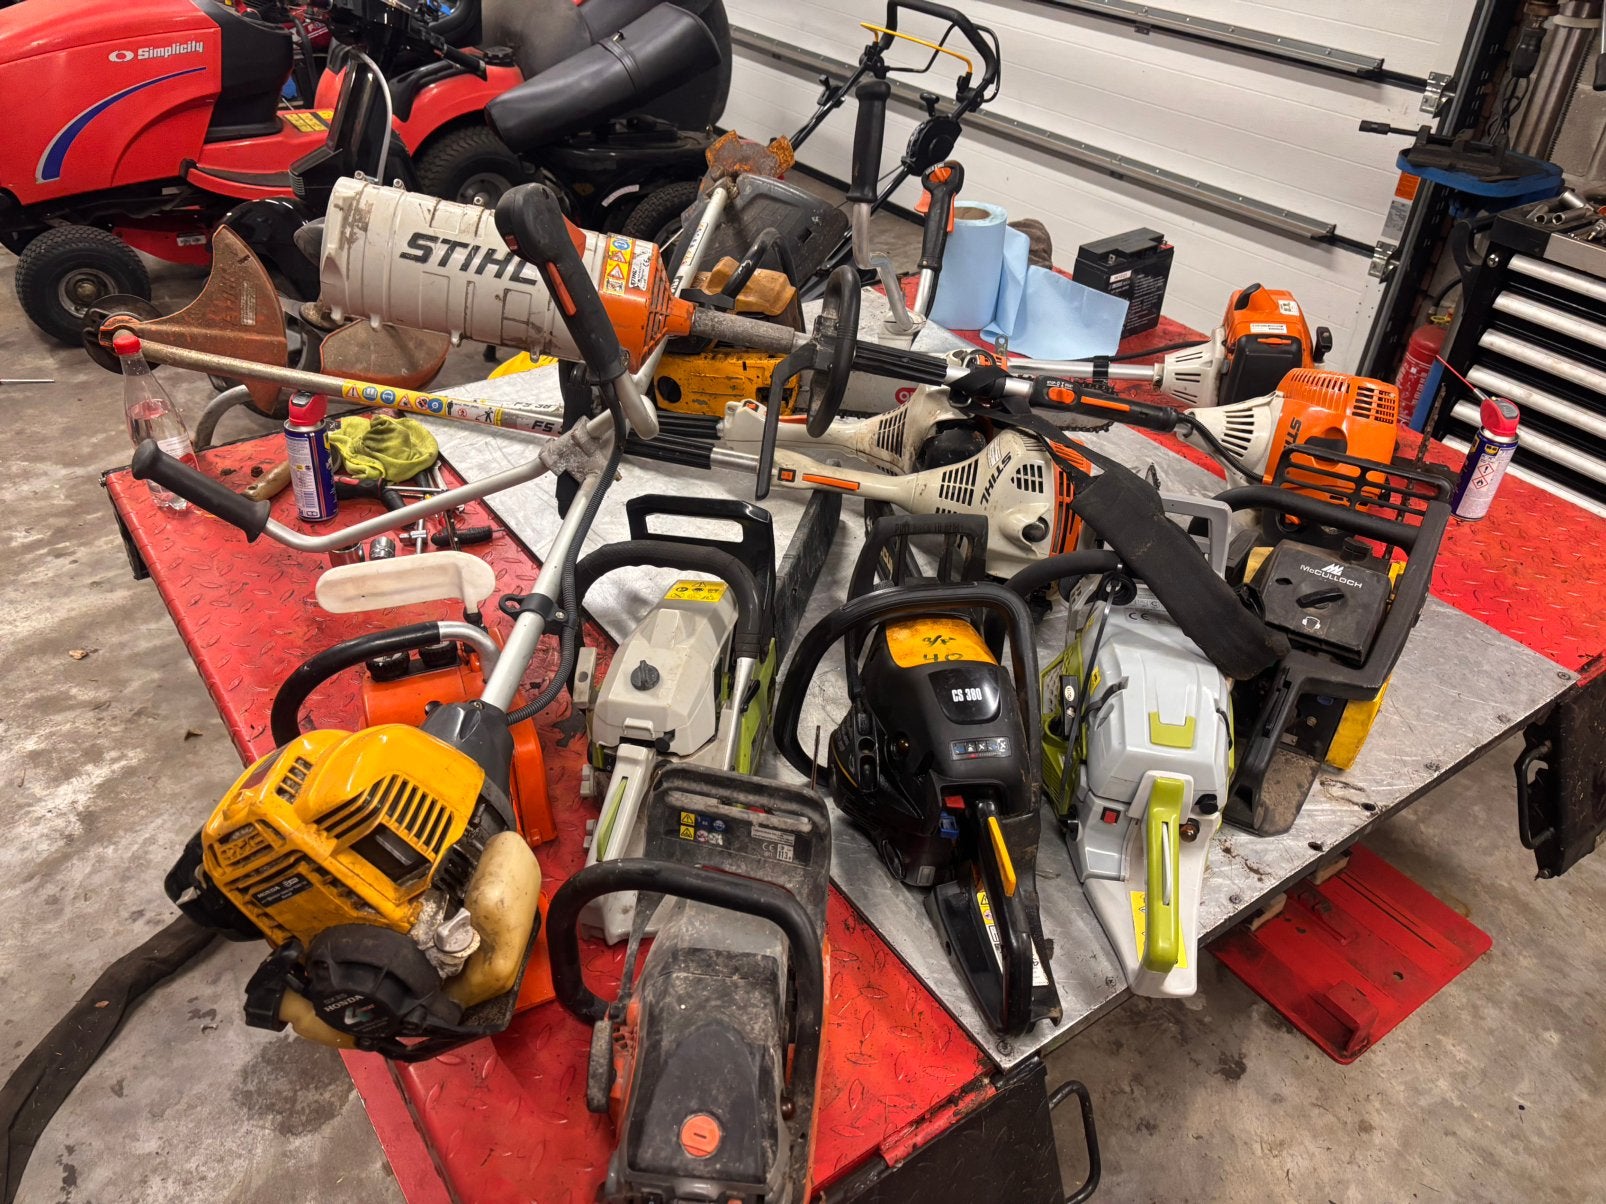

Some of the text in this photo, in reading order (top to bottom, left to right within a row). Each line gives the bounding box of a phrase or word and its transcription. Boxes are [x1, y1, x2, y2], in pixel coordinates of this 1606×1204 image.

[138, 41, 203, 59] Simplicity
[399, 232, 538, 286] STIHL
[532, 420, 554, 432] FS
[980, 451, 1011, 504] STIHL
[1300, 564, 1363, 588] McCULLOCH
[951, 688, 982, 702] CS 380
[324, 995, 365, 1012] HONDA
